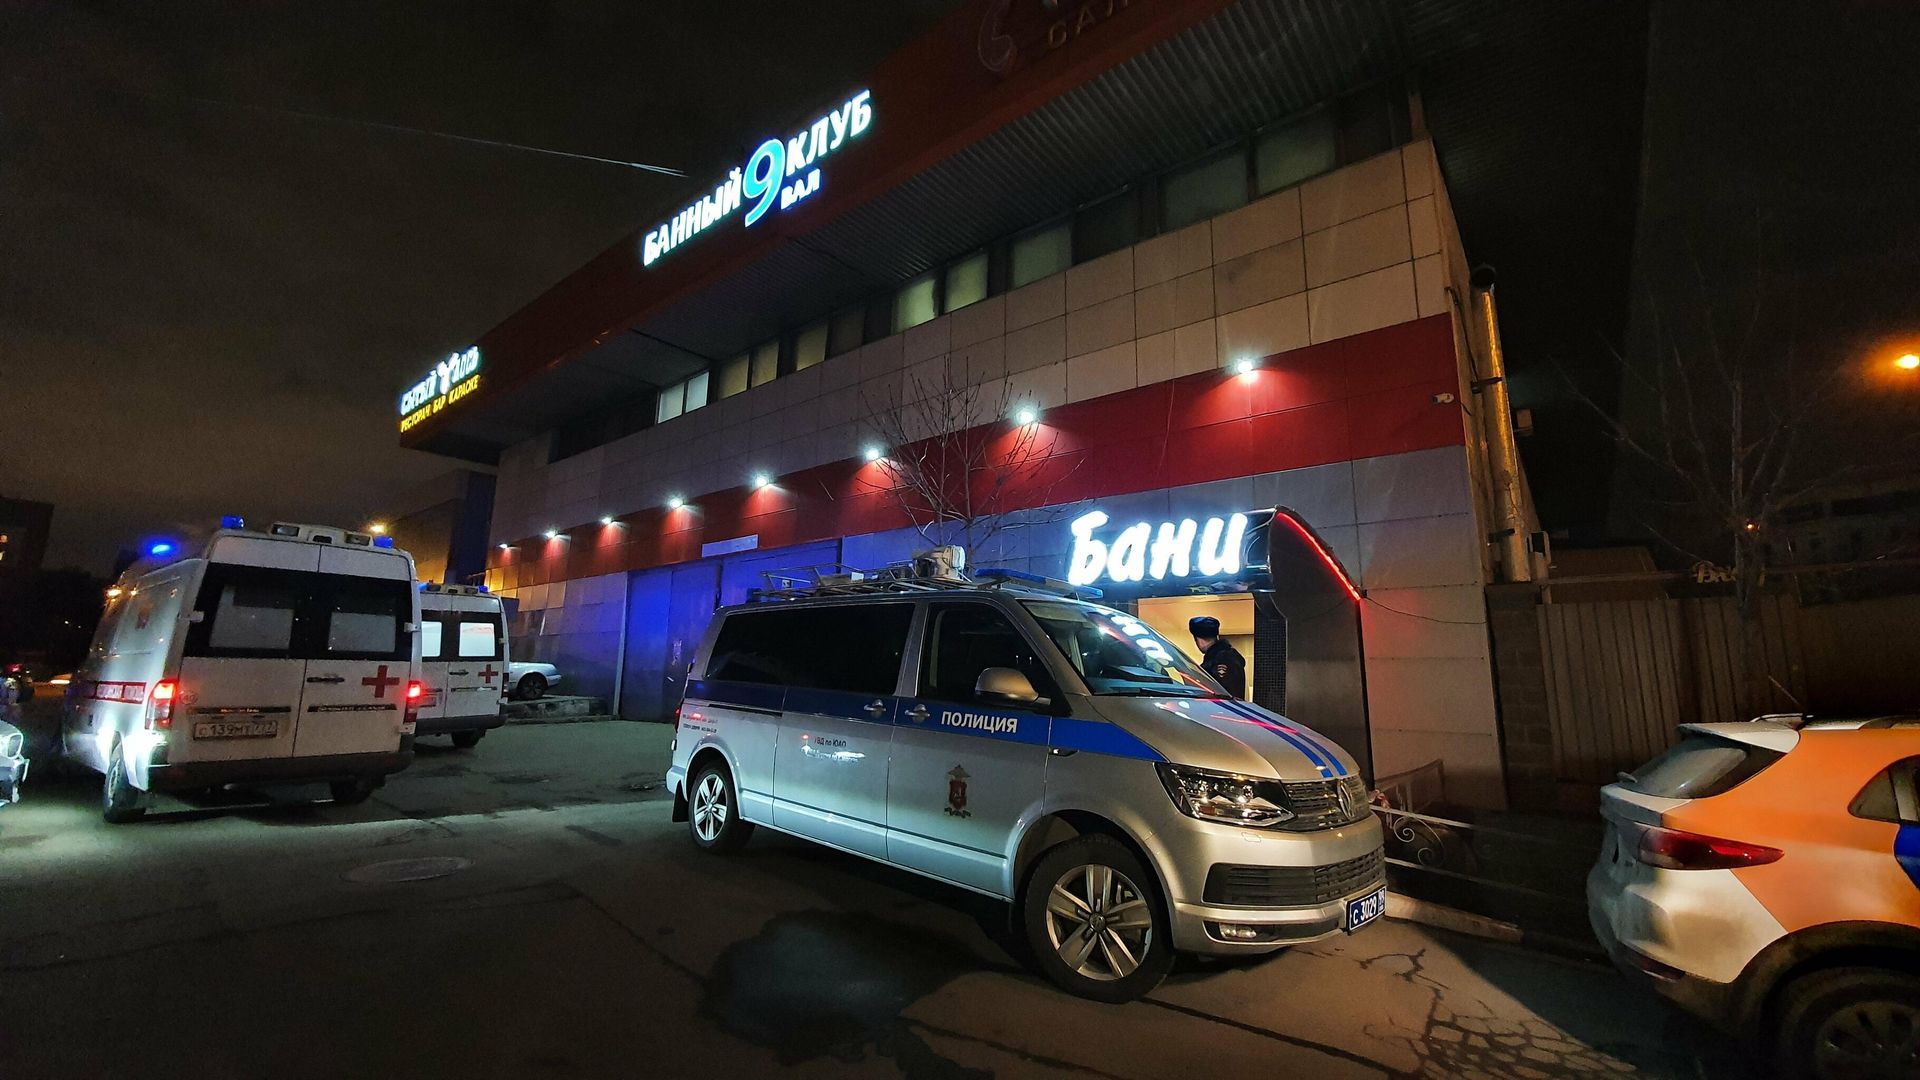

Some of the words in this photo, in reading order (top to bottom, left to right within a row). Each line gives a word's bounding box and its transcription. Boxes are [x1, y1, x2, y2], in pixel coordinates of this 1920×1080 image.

[642, 166, 741, 267] БАННЫЙ
[743, 138, 786, 228] 9
[786, 88, 872, 175] КЛУБ
[780, 168, 821, 210] ВАЛ
[433, 395, 446, 413] БАР
[448, 375, 480, 404] КАРАОКЕ
[1067, 510, 1248, 586] Бани
[941, 710, 1018, 735] ПОЛИЦИЯ
